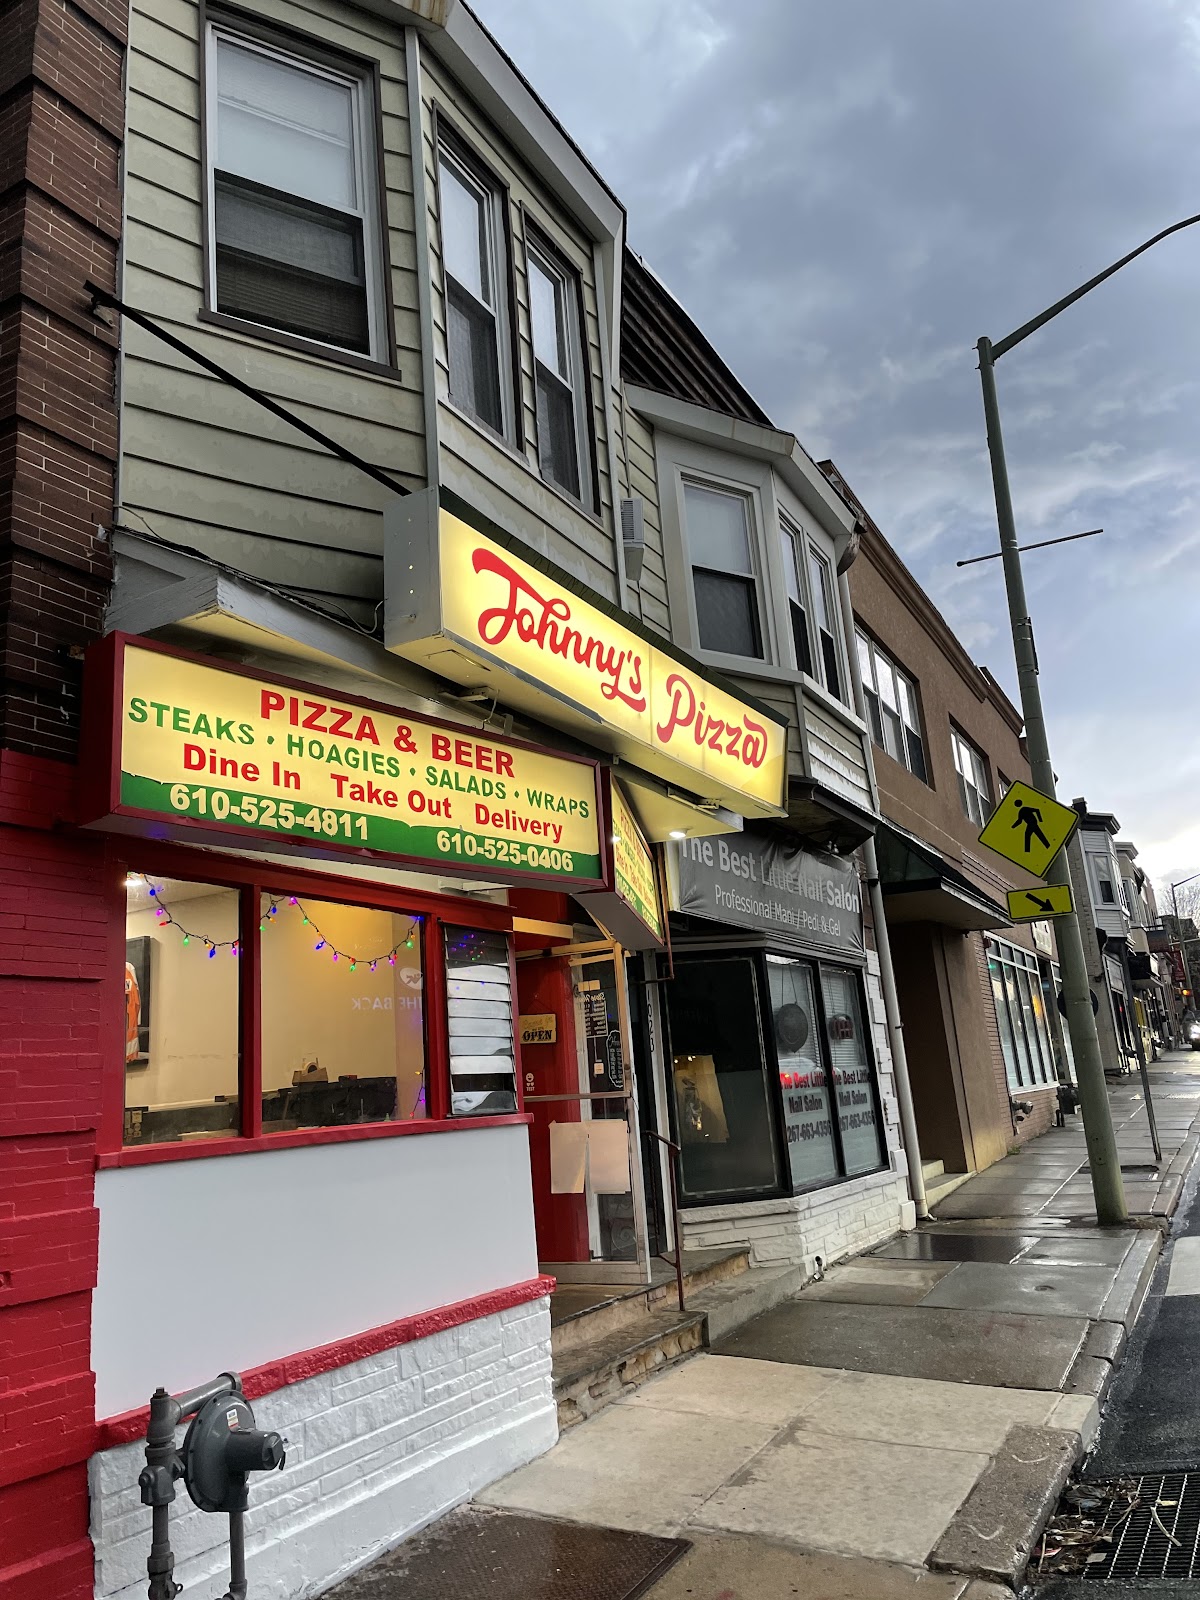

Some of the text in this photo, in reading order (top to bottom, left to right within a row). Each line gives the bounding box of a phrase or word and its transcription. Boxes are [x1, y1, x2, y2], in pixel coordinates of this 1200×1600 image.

[472, 548, 768, 768] Johnny's Pizza
[128, 697, 590, 819] STEAKS HOAGIES SALADS WRAPS
[261, 689, 515, 778] PIZZA & BEER
[170, 783, 368, 841] 610-525-4811
[183, 743, 563, 844] Dine In Take Out Delivery
[437, 830, 574, 872] 610-525-0406
[717, 840, 757, 882] Best
[826, 880, 860, 914] Salon
[715, 884, 772, 920] Professional
[774, 902, 796, 926] Mani
[803, 911, 819, 932] Pedi
[828, 918, 841, 937] Gel
[522, 1030, 553, 1042] OPEN
[789, 1094, 823, 1113] Nail Salon
